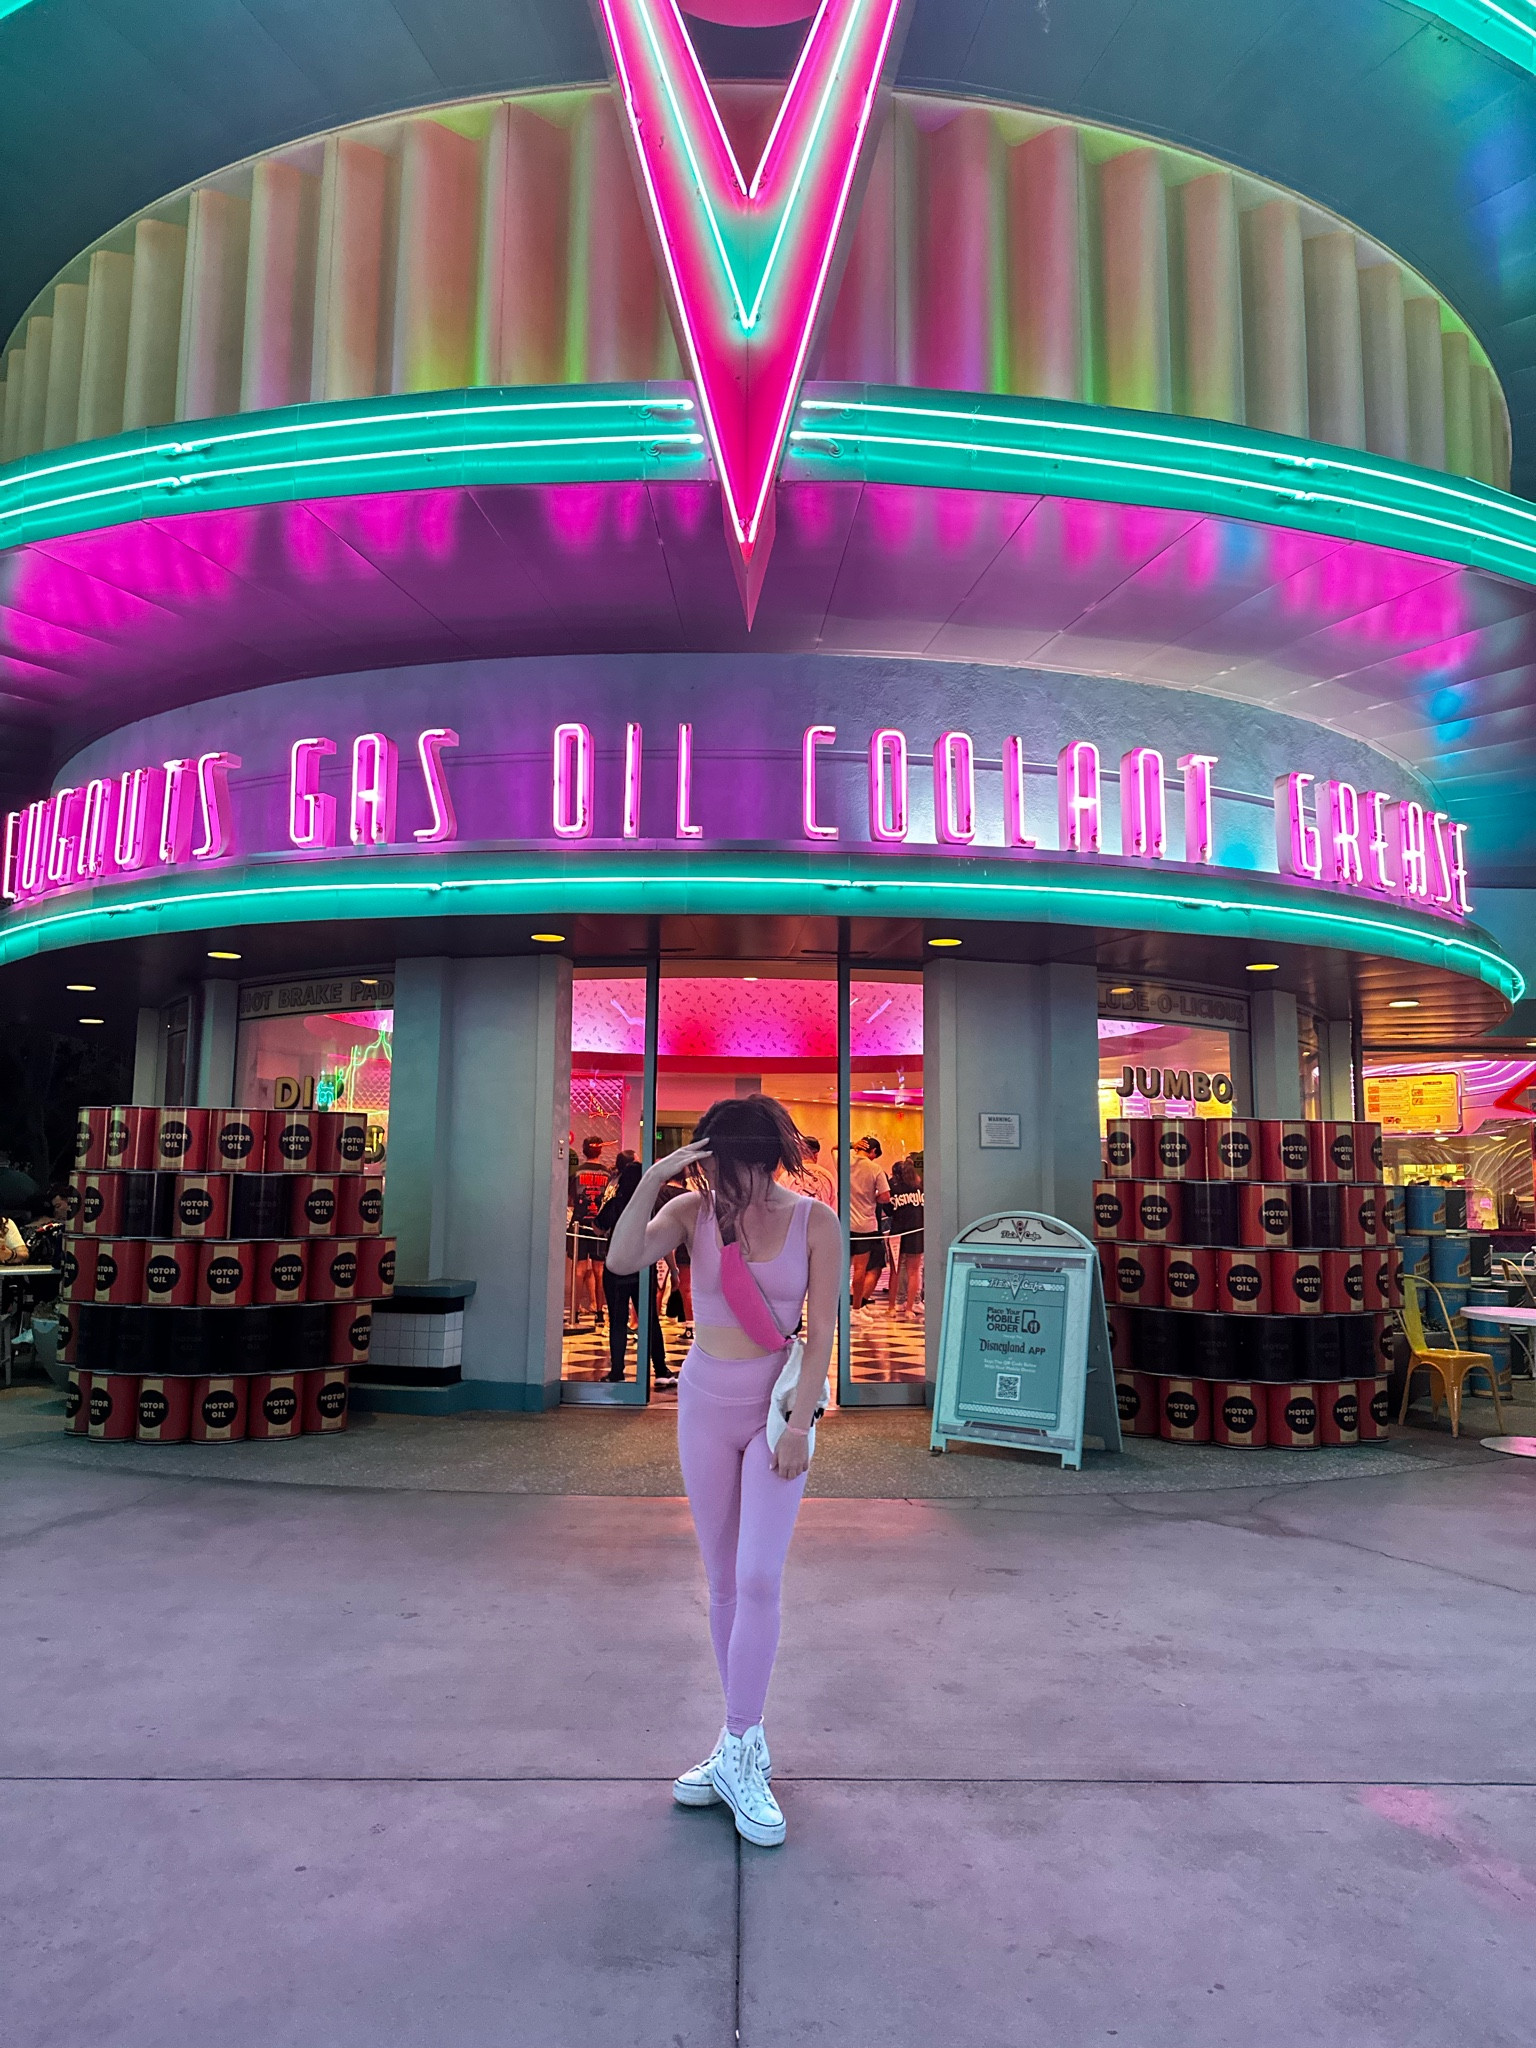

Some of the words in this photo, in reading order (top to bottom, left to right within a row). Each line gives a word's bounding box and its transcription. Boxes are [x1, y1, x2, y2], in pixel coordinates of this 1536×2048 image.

[289, 729, 460, 848] GAS
[552, 721, 702, 839] OIL
[802, 724, 1219, 865] COOLANT
[1273, 771, 1474, 917] GREASE
[278, 982, 342, 1008] BRAKE
[1116, 1066, 1234, 1104] JUMBO
[986, 1314, 1020, 1324] MOBILE
[987, 1323, 1018, 1332] ORDER
[979, 1338, 1025, 1354] Disneyland
[1028, 1347, 1046, 1355] APP
